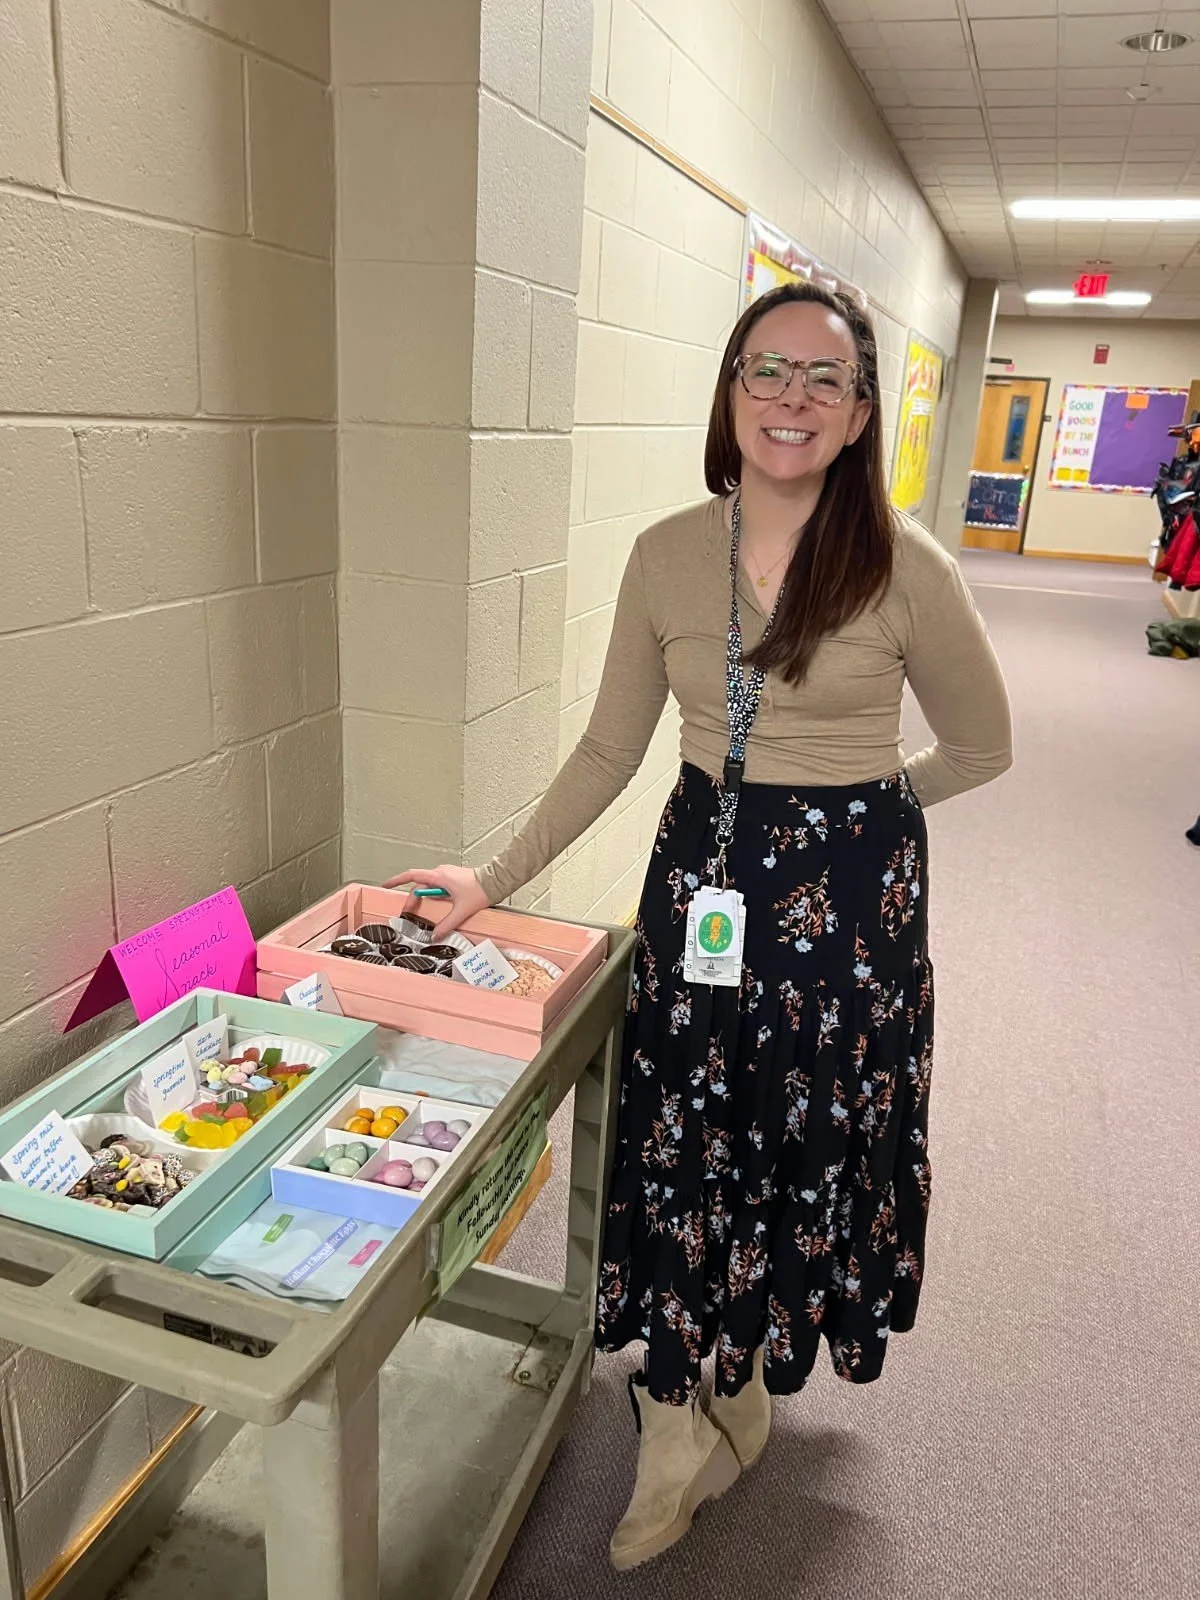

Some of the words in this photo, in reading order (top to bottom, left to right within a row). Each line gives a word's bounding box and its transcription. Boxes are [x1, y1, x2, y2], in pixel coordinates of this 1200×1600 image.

[1079, 274, 1109, 297] EXIT
[1068, 400, 1094, 411] GOOD
[1067, 415, 1097, 426] BOOKS
[1062, 445, 1090, 457] BUNCH
[118, 927, 162, 958] WELCOME
[162, 1074, 186, 1101] gummies
[39, 1121, 55, 1139] mix
[21, 1154, 41, 1180] butter
[43, 1135, 63, 1157] toffee
[456, 1191, 480, 1228] Kindly
[481, 1164, 504, 1197] return
[466, 1183, 503, 1233] Fellowship
[474, 1205, 501, 1244] Sunday
